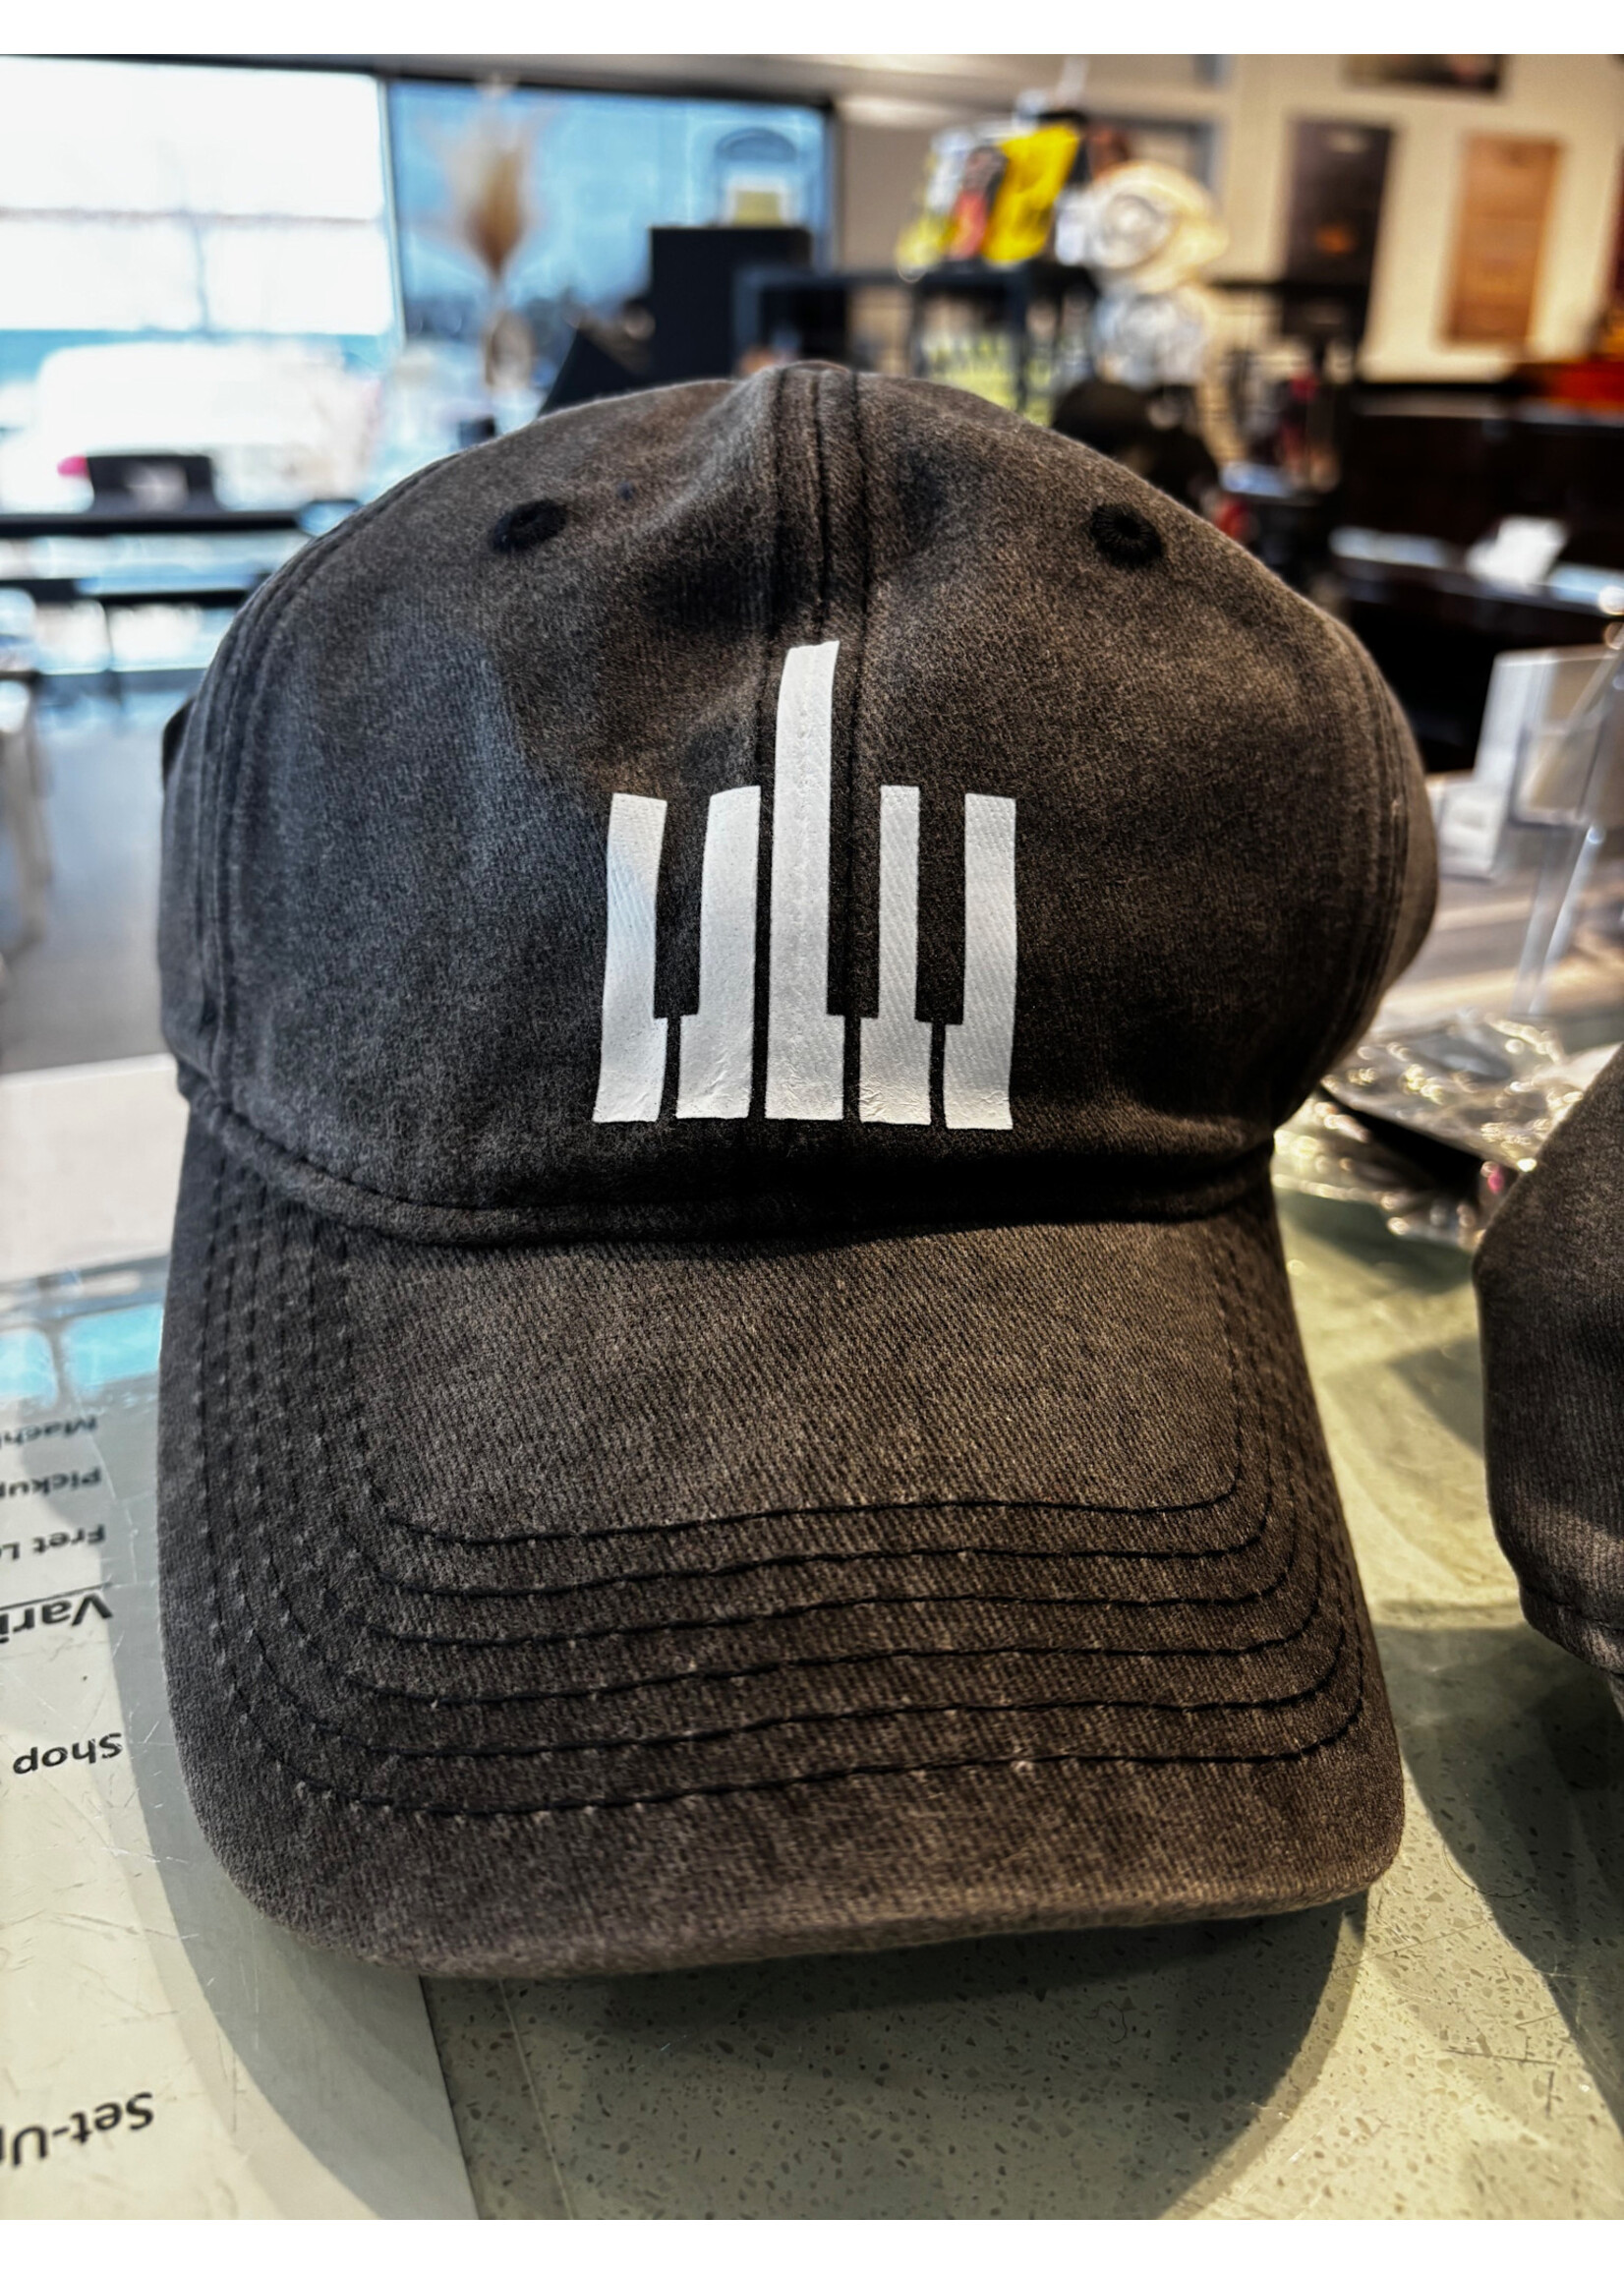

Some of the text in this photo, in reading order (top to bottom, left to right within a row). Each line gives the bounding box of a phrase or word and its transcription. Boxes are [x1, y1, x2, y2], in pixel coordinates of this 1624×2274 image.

[0, 1415, 97, 1448] Mach
[0, 1524, 105, 1559] Fret L
[13, 1731, 123, 1775] Shop
